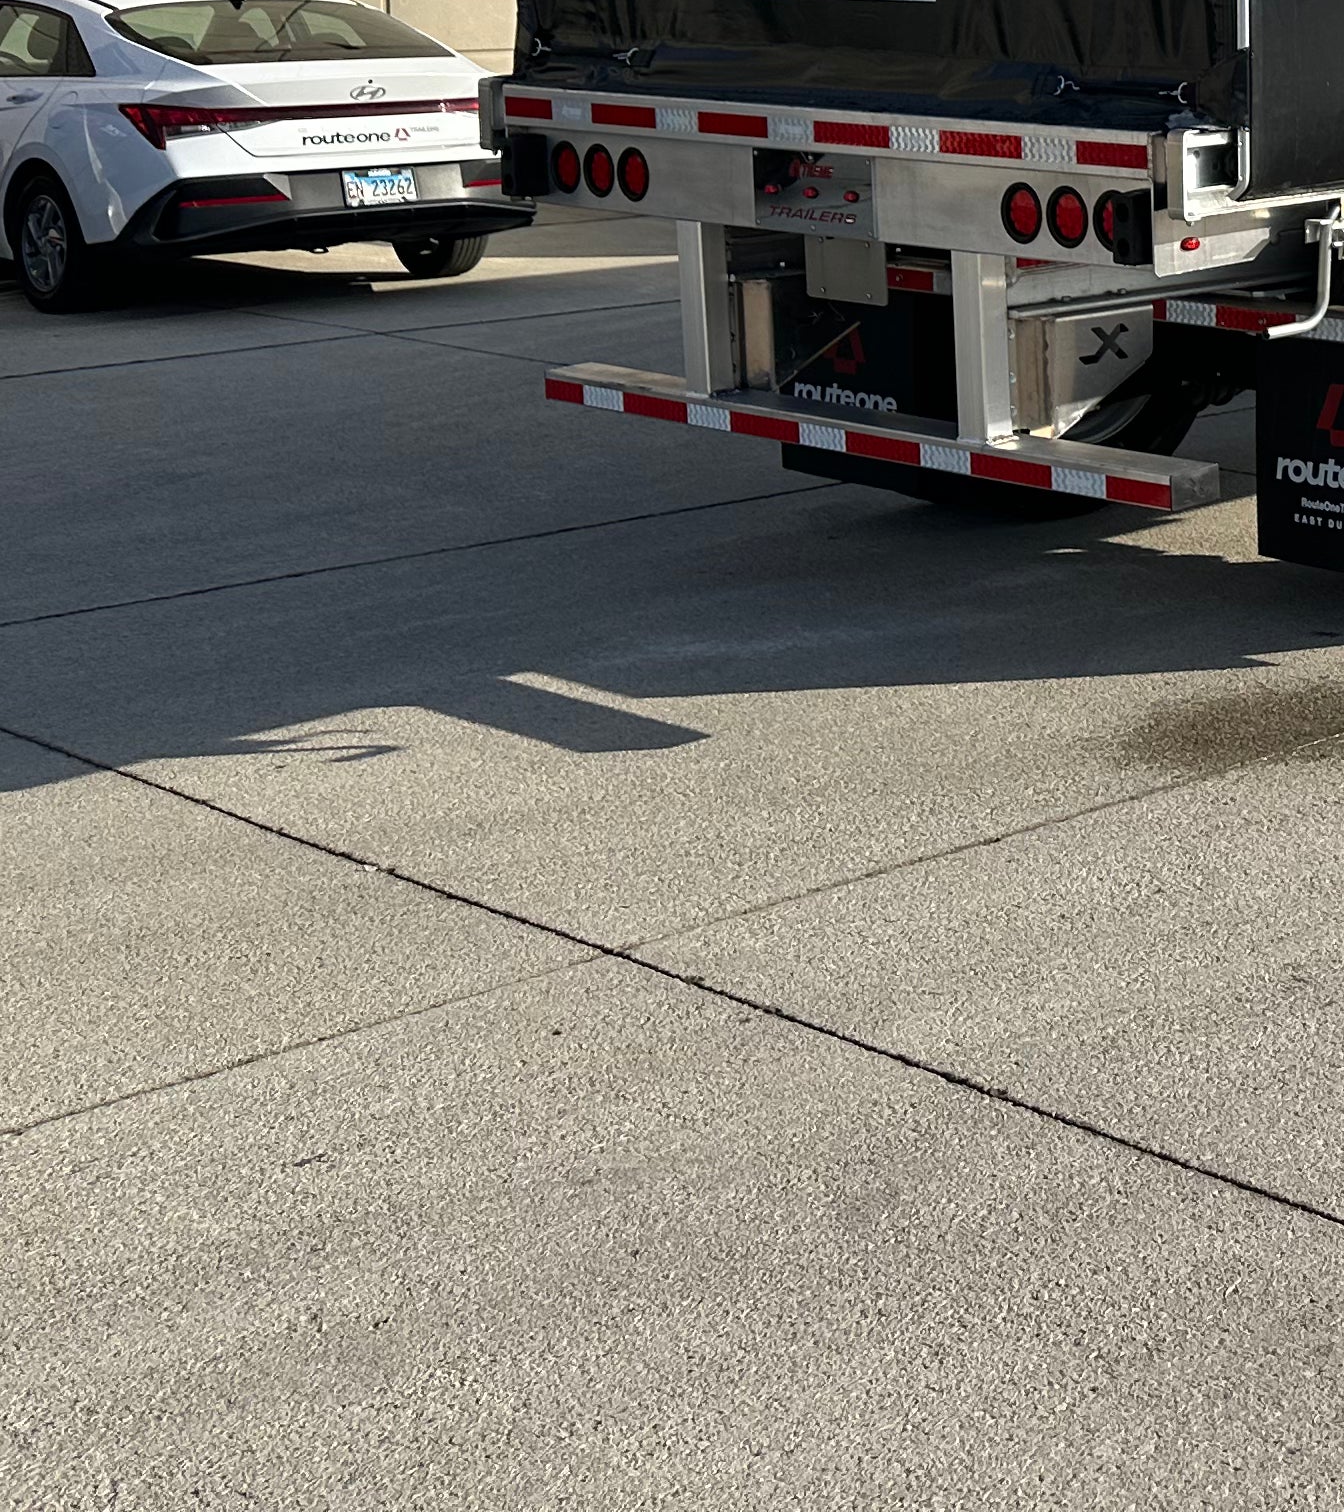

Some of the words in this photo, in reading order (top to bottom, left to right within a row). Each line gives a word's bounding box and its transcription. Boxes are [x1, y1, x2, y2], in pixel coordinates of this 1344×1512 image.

[302, 132, 391, 146] routeone
[371, 177, 414, 197] 23262
[769, 204, 857, 226] TRAILERS
[793, 381, 898, 413] routeone
[1294, 513, 1323, 527] EAST
